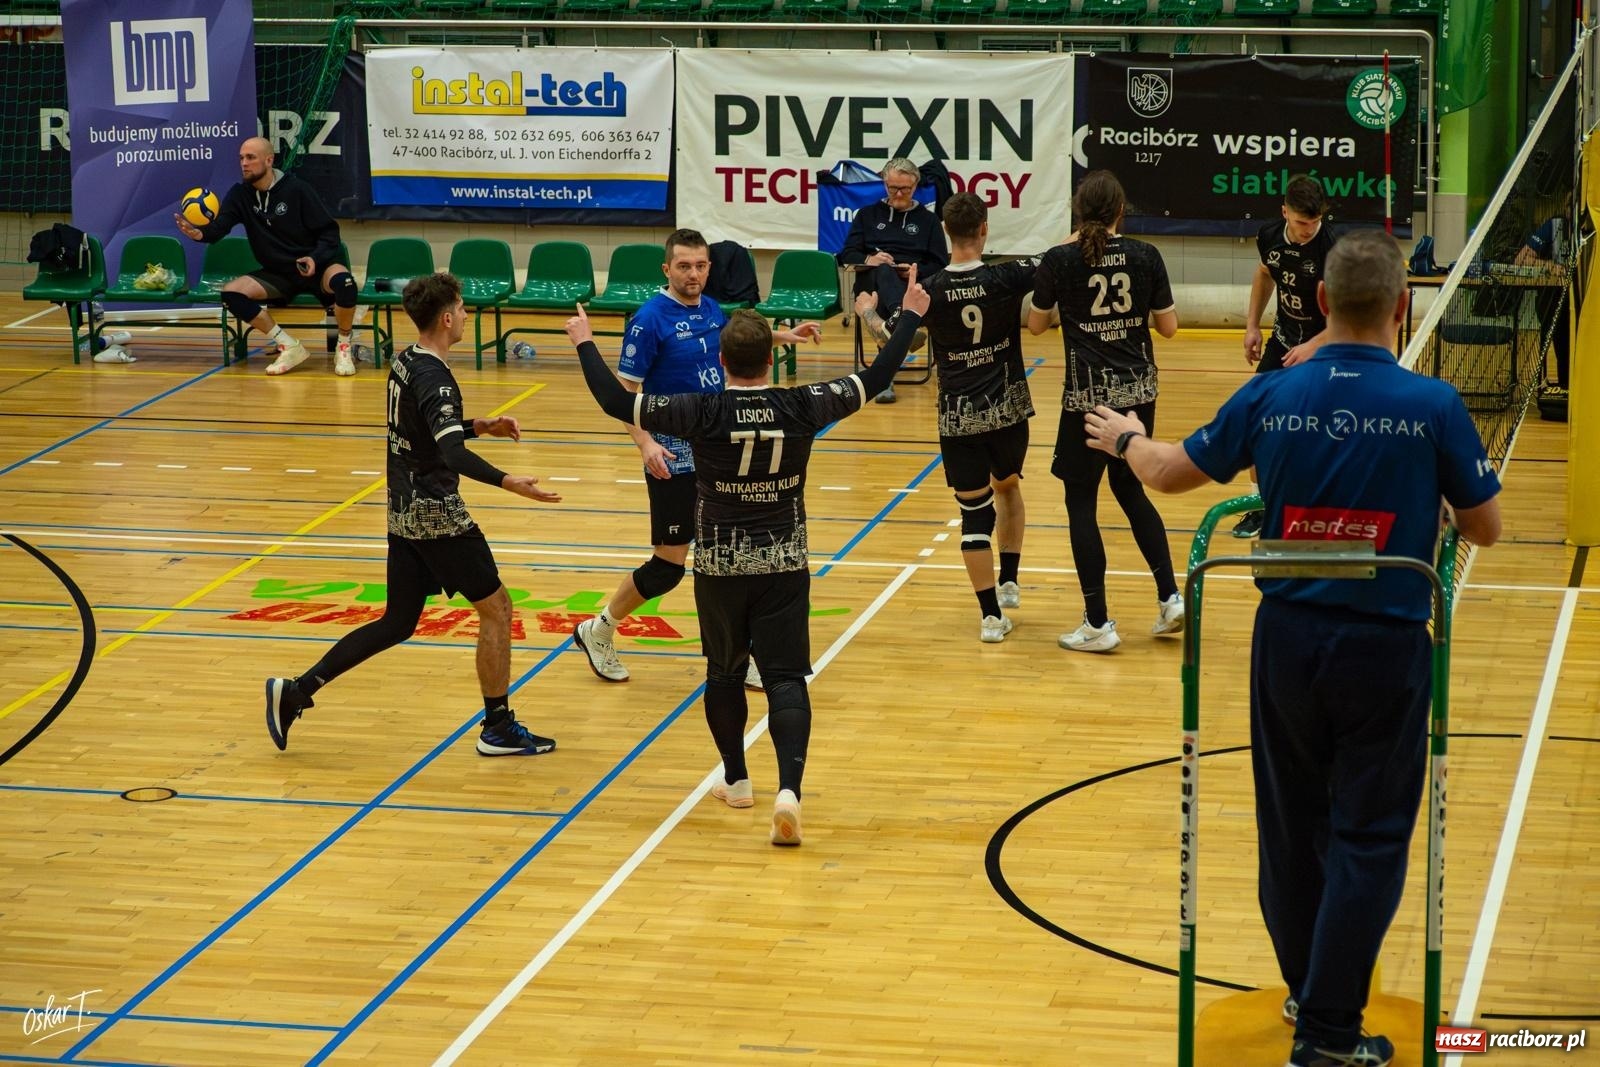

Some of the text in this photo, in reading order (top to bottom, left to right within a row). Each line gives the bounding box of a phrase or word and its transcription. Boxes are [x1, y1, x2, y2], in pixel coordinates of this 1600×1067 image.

[119, 19, 200, 104] bmp
[411, 66, 627, 116] instal-tech
[1351, 78, 1367, 98] KLUB
[89, 124, 158, 145] budujemy
[161, 121, 239, 141] możliwości
[382, 127, 660, 143] tel. 32 414 92 88, 502 632 695, 606 363 647
[714, 94, 1034, 162] PIVEXIN
[1100, 126, 1199, 148] Racibórz
[116, 145, 213, 167] porozumienia
[392, 145, 652, 160] 47-400 Racibórz, ul. J. von Eichendorffa 2
[1212, 128, 1356, 162] wspiera
[1135, 152, 1162, 166] 1217
[451, 184, 593, 203] www.instal-tech.pl
[715, 167, 1032, 209] TECHGY
[1282, 271, 1296, 287] 32
[945, 285, 987, 302] TATERKA
[1088, 272, 1133, 317] 23
[961, 304, 983, 345] 9
[1079, 319, 1125, 333] SIATKARSKI
[698, 366, 721, 388] KB
[388, 379, 401, 428] 17
[735, 408, 775, 424] LISICKI
[1363, 418, 1426, 438] KRAK
[730, 429, 785, 477] 77
[715, 474, 800, 494] SIATKARSKI KLUB
[1288, 517, 1378, 538] martes
